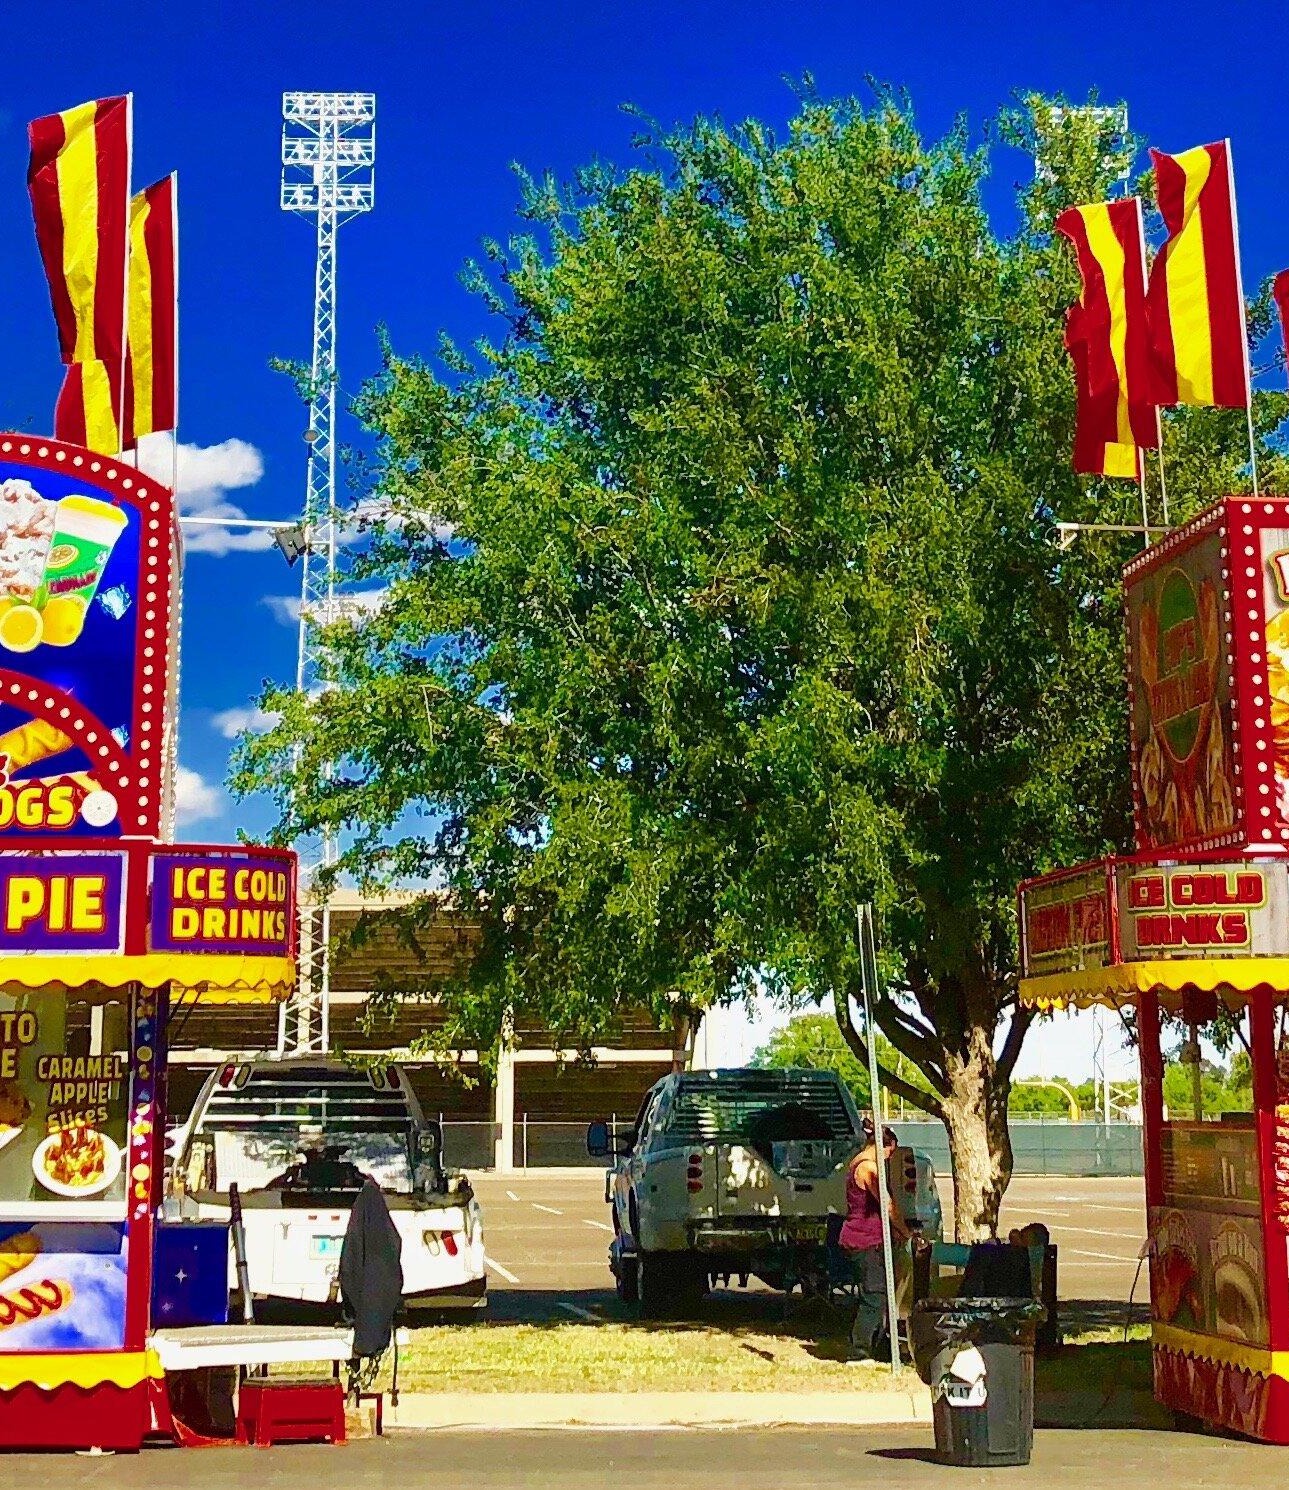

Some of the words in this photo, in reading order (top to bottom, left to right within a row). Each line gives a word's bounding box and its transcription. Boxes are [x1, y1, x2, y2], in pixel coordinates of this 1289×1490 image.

[172, 867, 226, 902] ICE
[234, 869, 286, 903] COLD
[1172, 873, 1265, 907] COLD
[5, 876, 106, 931] PIE
[172, 907, 286, 941] DRINKS
[38, 1056, 123, 1079] CARAMEL
[50, 1082, 109, 1104] APPLE
